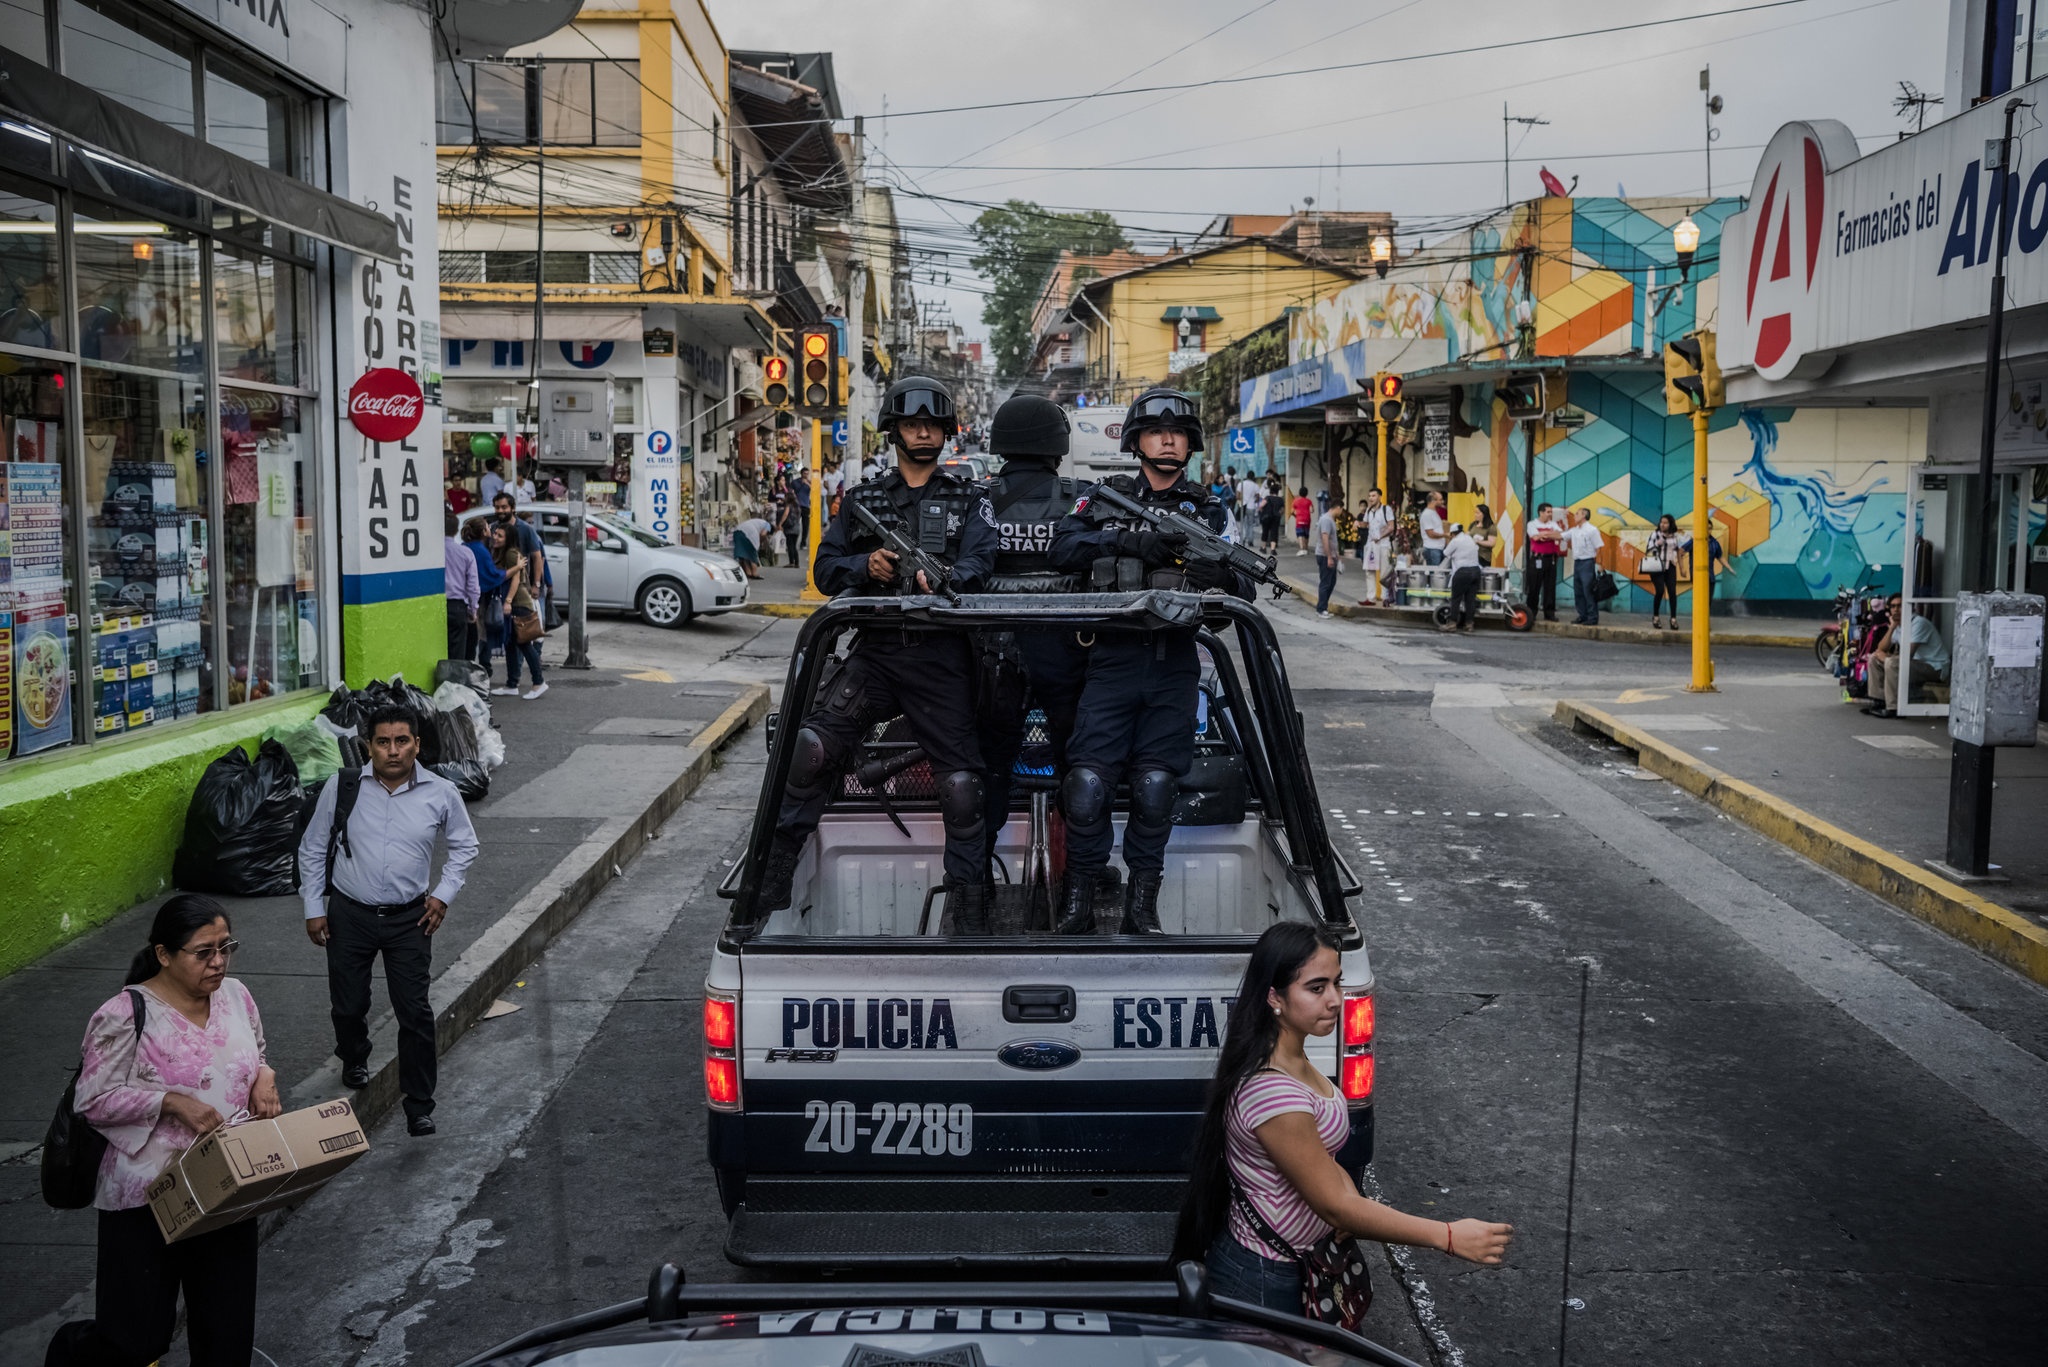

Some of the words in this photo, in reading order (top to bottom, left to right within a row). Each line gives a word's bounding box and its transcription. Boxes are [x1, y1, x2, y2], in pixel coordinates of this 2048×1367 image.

[1836, 191, 1911, 257] Farmacias
[1916, 173, 1941, 230] del
[394, 175, 420, 557] ENGARGLADO
[351, 391, 421, 418] Coca-Cola
[362, 263, 389, 559] COAS
[651, 479, 669, 539] MAYO
[996, 521, 1055, 539] OLICÍ
[997, 536, 1052, 552] STAT
[782, 997, 959, 1049] POLICIA
[1017, 1046, 1061, 1067] Ford
[805, 1100, 973, 1157] 20-2289
[256, 1162, 285, 1175] Vasos
[267, 1152, 281, 1164] 24
[1240, 1200, 1263, 1230] BETTY
